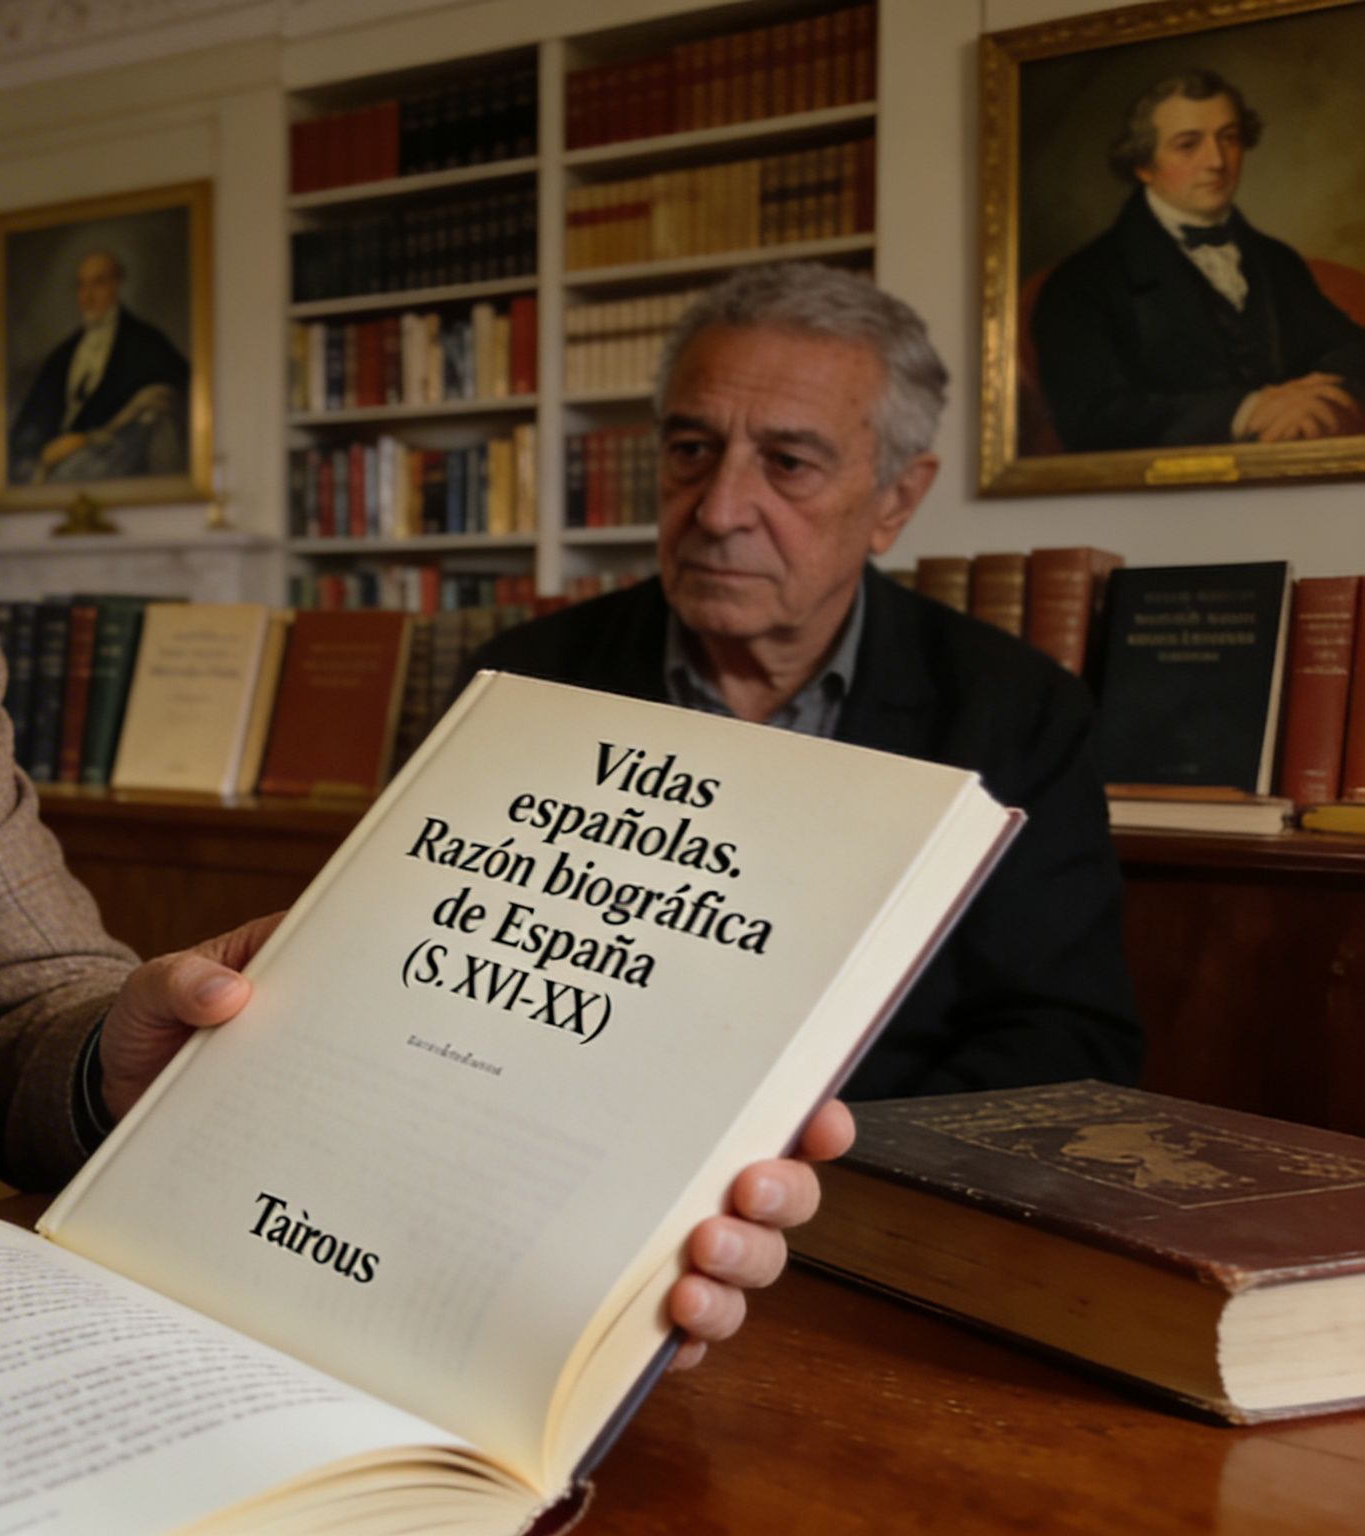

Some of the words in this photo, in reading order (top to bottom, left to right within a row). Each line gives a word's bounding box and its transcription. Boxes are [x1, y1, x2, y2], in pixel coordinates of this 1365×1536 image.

[596, 741, 720, 809] Vidas
[406, 817, 536, 888] Razón
[541, 851, 773, 955] biográfica
[508, 793, 741, 879] españolas.
[432, 887, 487, 934] de
[490, 901, 656, 989] España
[402, 939, 444, 988] (S.
[450, 954, 612, 1045] XVI-XX)
